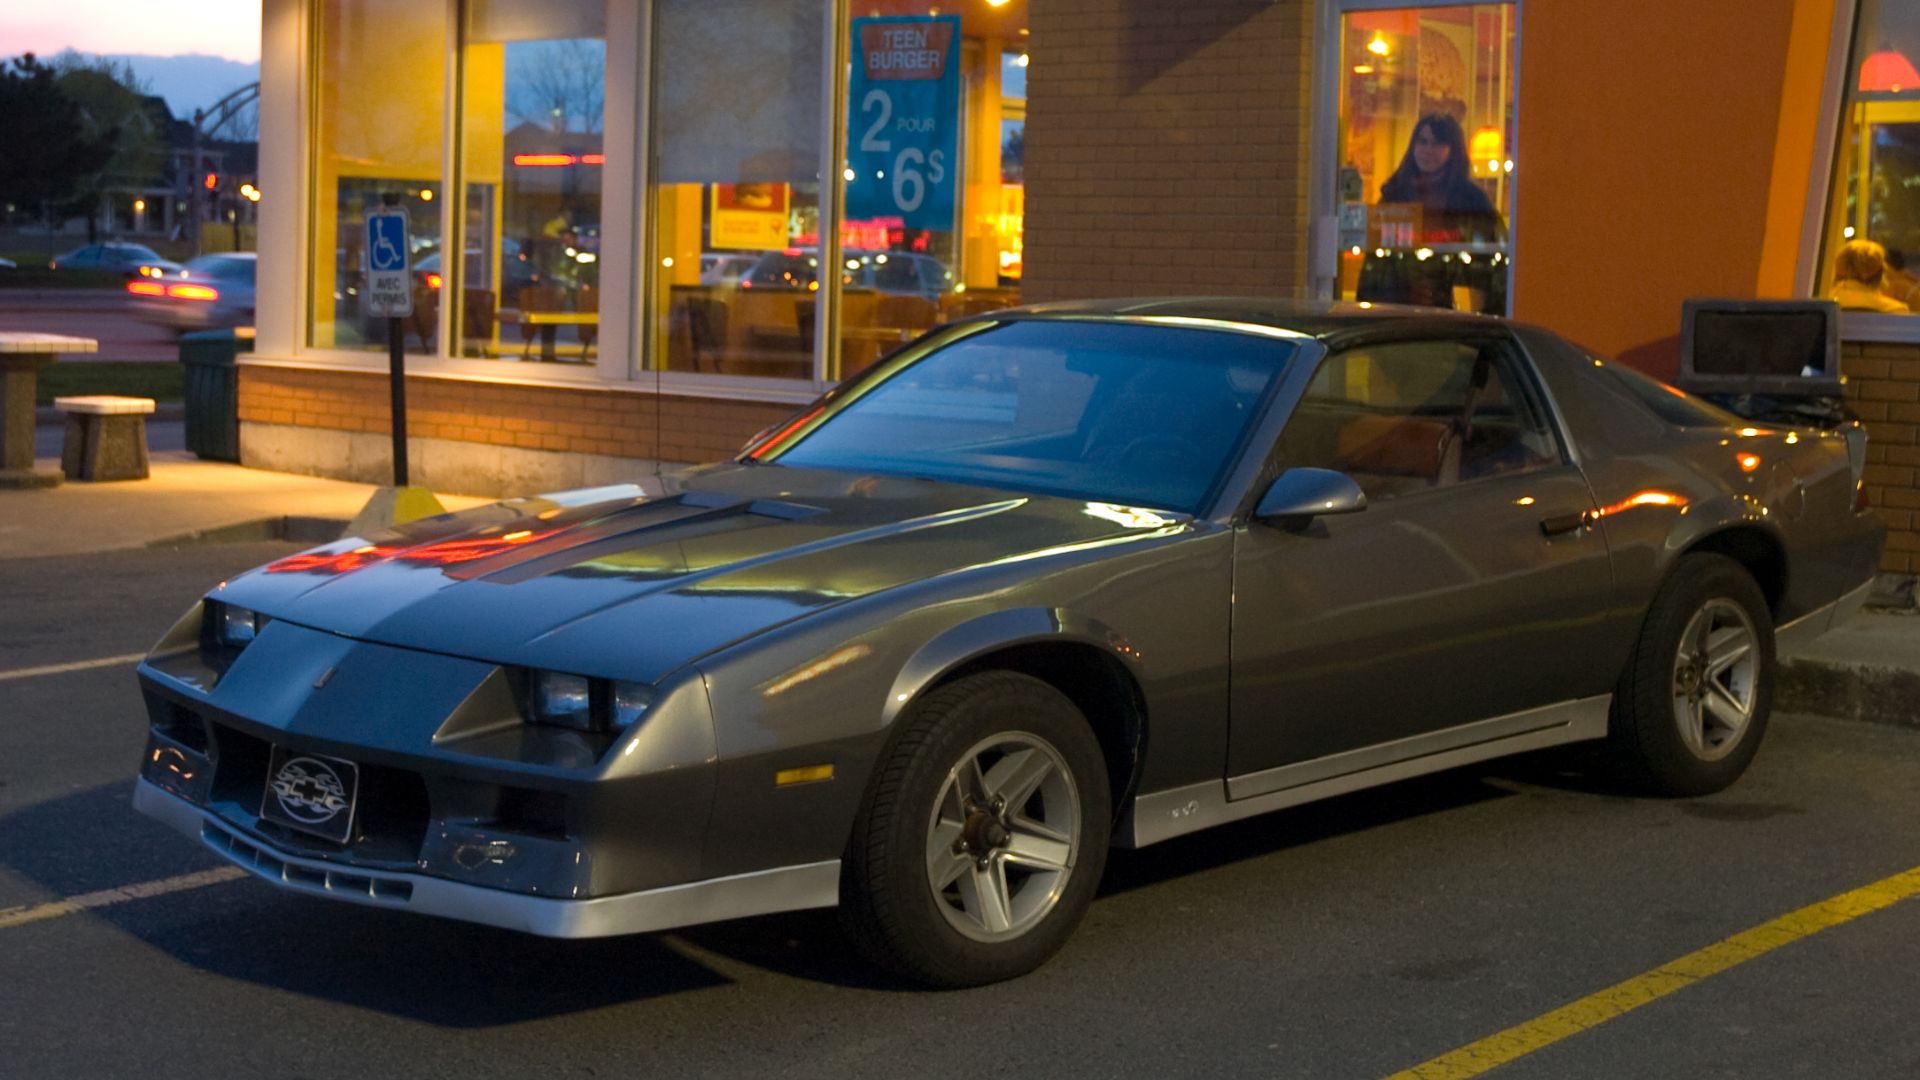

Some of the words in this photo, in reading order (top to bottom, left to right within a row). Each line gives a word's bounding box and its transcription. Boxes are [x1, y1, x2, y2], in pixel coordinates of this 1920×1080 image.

[883, 30, 927, 48] TEEN
[869, 51, 940, 69] BURGER
[860, 89, 892, 152] 2
[897, 117, 935, 131] POUR
[376, 277, 401, 290] AVEC
[371, 292, 407, 305] PERMIS
